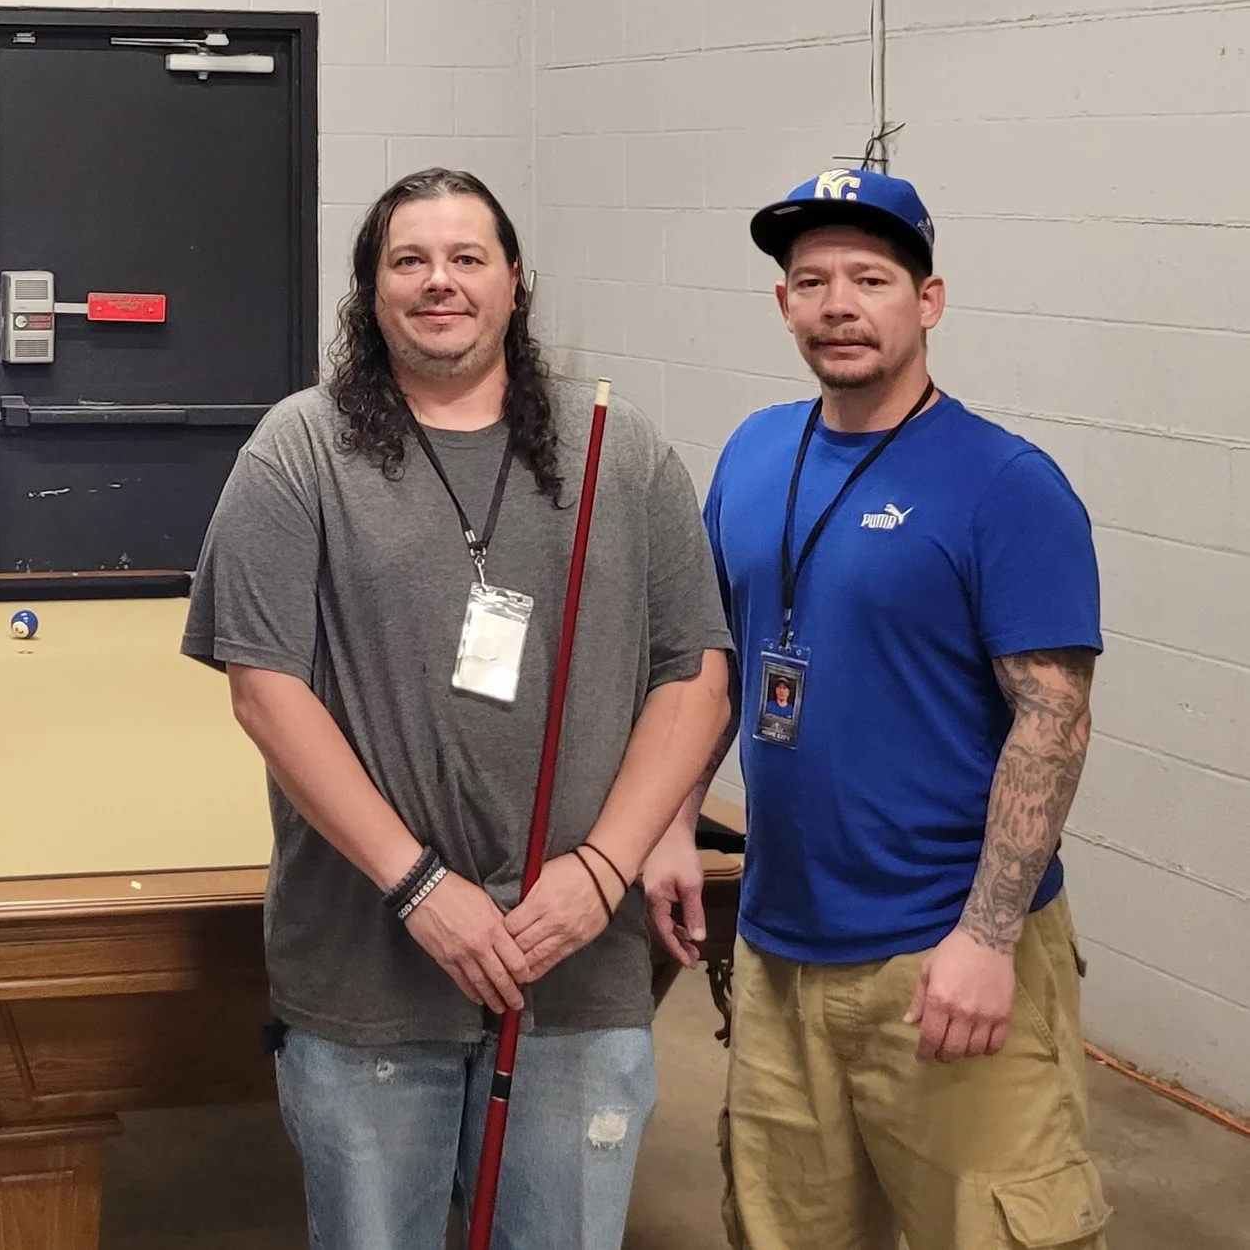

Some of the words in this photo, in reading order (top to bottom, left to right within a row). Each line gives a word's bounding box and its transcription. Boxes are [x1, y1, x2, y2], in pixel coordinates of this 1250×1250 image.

[861, 513, 897, 529] PUMA
[397, 903, 413, 919] GOD
[410, 880, 435, 906] BLESS
[431, 866, 448, 883] YOU
